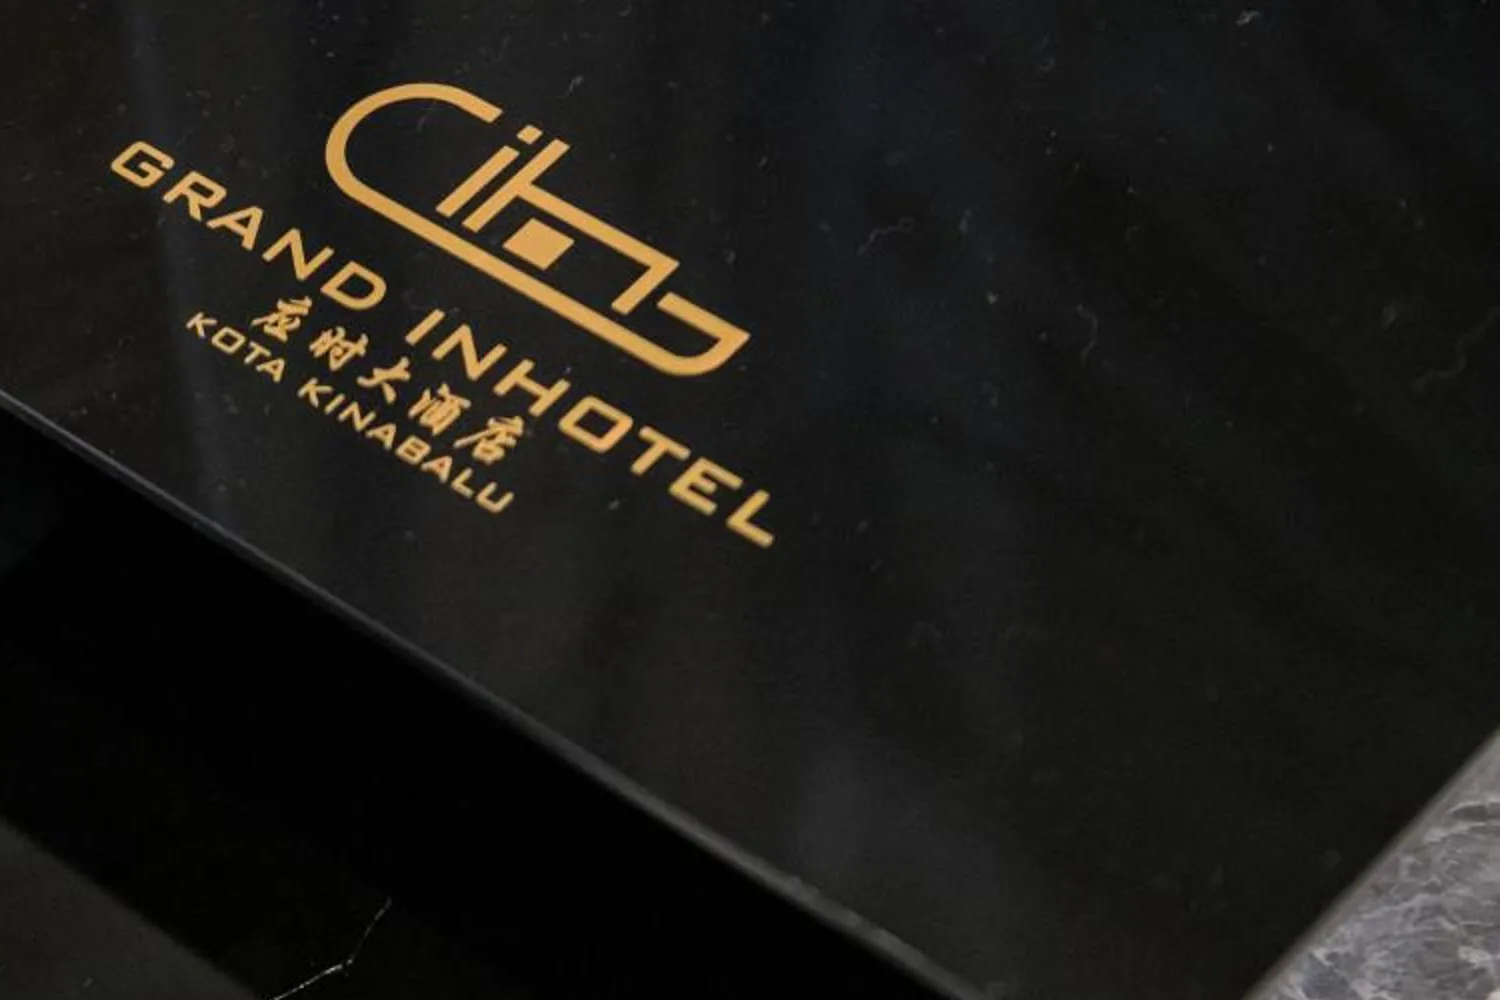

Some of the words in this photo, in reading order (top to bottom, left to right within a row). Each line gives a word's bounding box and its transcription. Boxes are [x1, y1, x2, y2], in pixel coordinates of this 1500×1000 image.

[110, 141, 387, 310] GRAND
[405, 309, 774, 547] INHOTEL
[186, 312, 286, 383] KOTA
[298, 378, 515, 514] KINABALU
